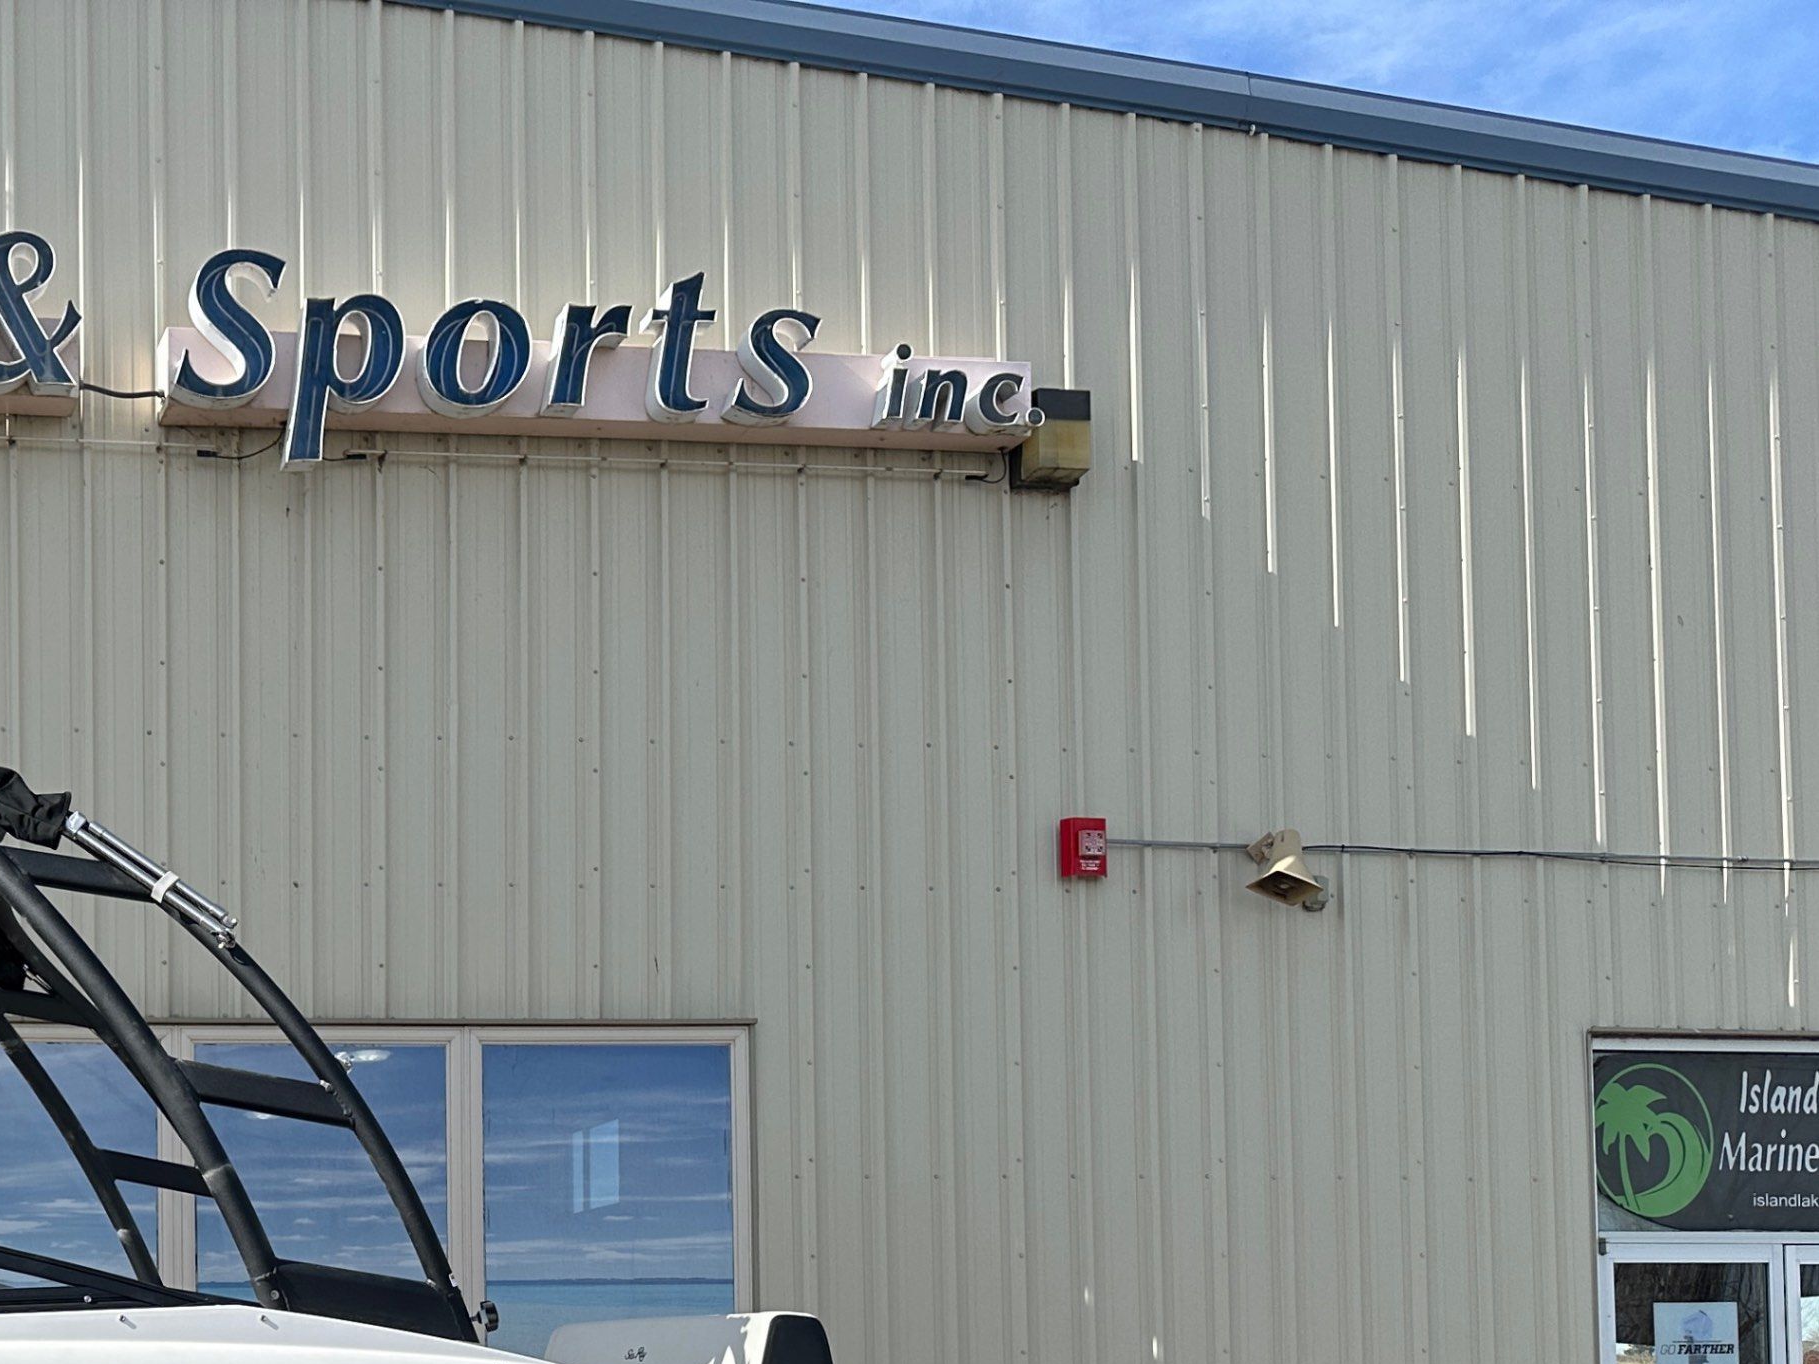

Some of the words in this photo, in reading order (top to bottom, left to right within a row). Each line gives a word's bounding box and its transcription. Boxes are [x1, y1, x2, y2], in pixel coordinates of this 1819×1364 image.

[169, 249, 822, 470] Sports
[1739, 1069, 1819, 1114] Island
[1719, 1129, 1819, 1172] Marine
[1660, 1344, 1677, 1356] GO
[1676, 1343, 1735, 1356] FARTHER
